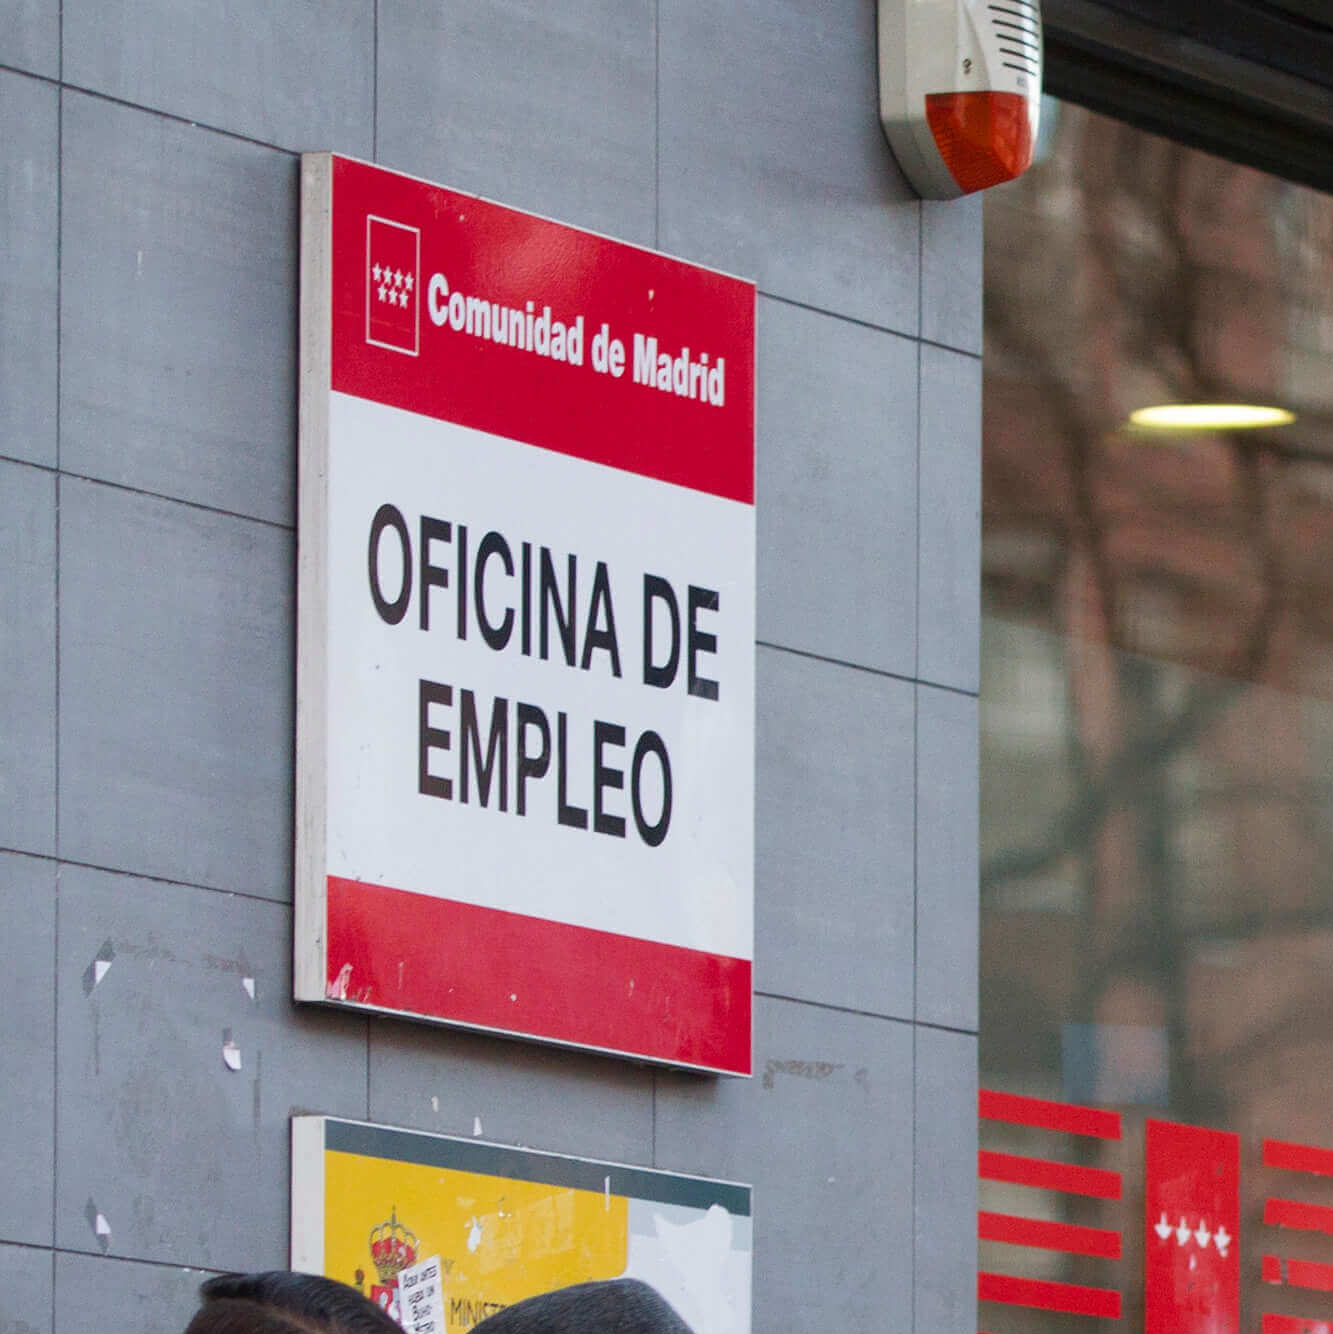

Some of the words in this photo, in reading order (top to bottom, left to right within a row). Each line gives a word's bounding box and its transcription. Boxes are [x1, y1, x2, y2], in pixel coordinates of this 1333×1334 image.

[428, 272, 584, 367] Comunidad
[592, 323, 626, 378] de
[633, 333, 726, 408] Madrid
[367, 502, 623, 679] OFICINA
[642, 572, 720, 702] DE
[418, 678, 674, 848] EMPLEO
